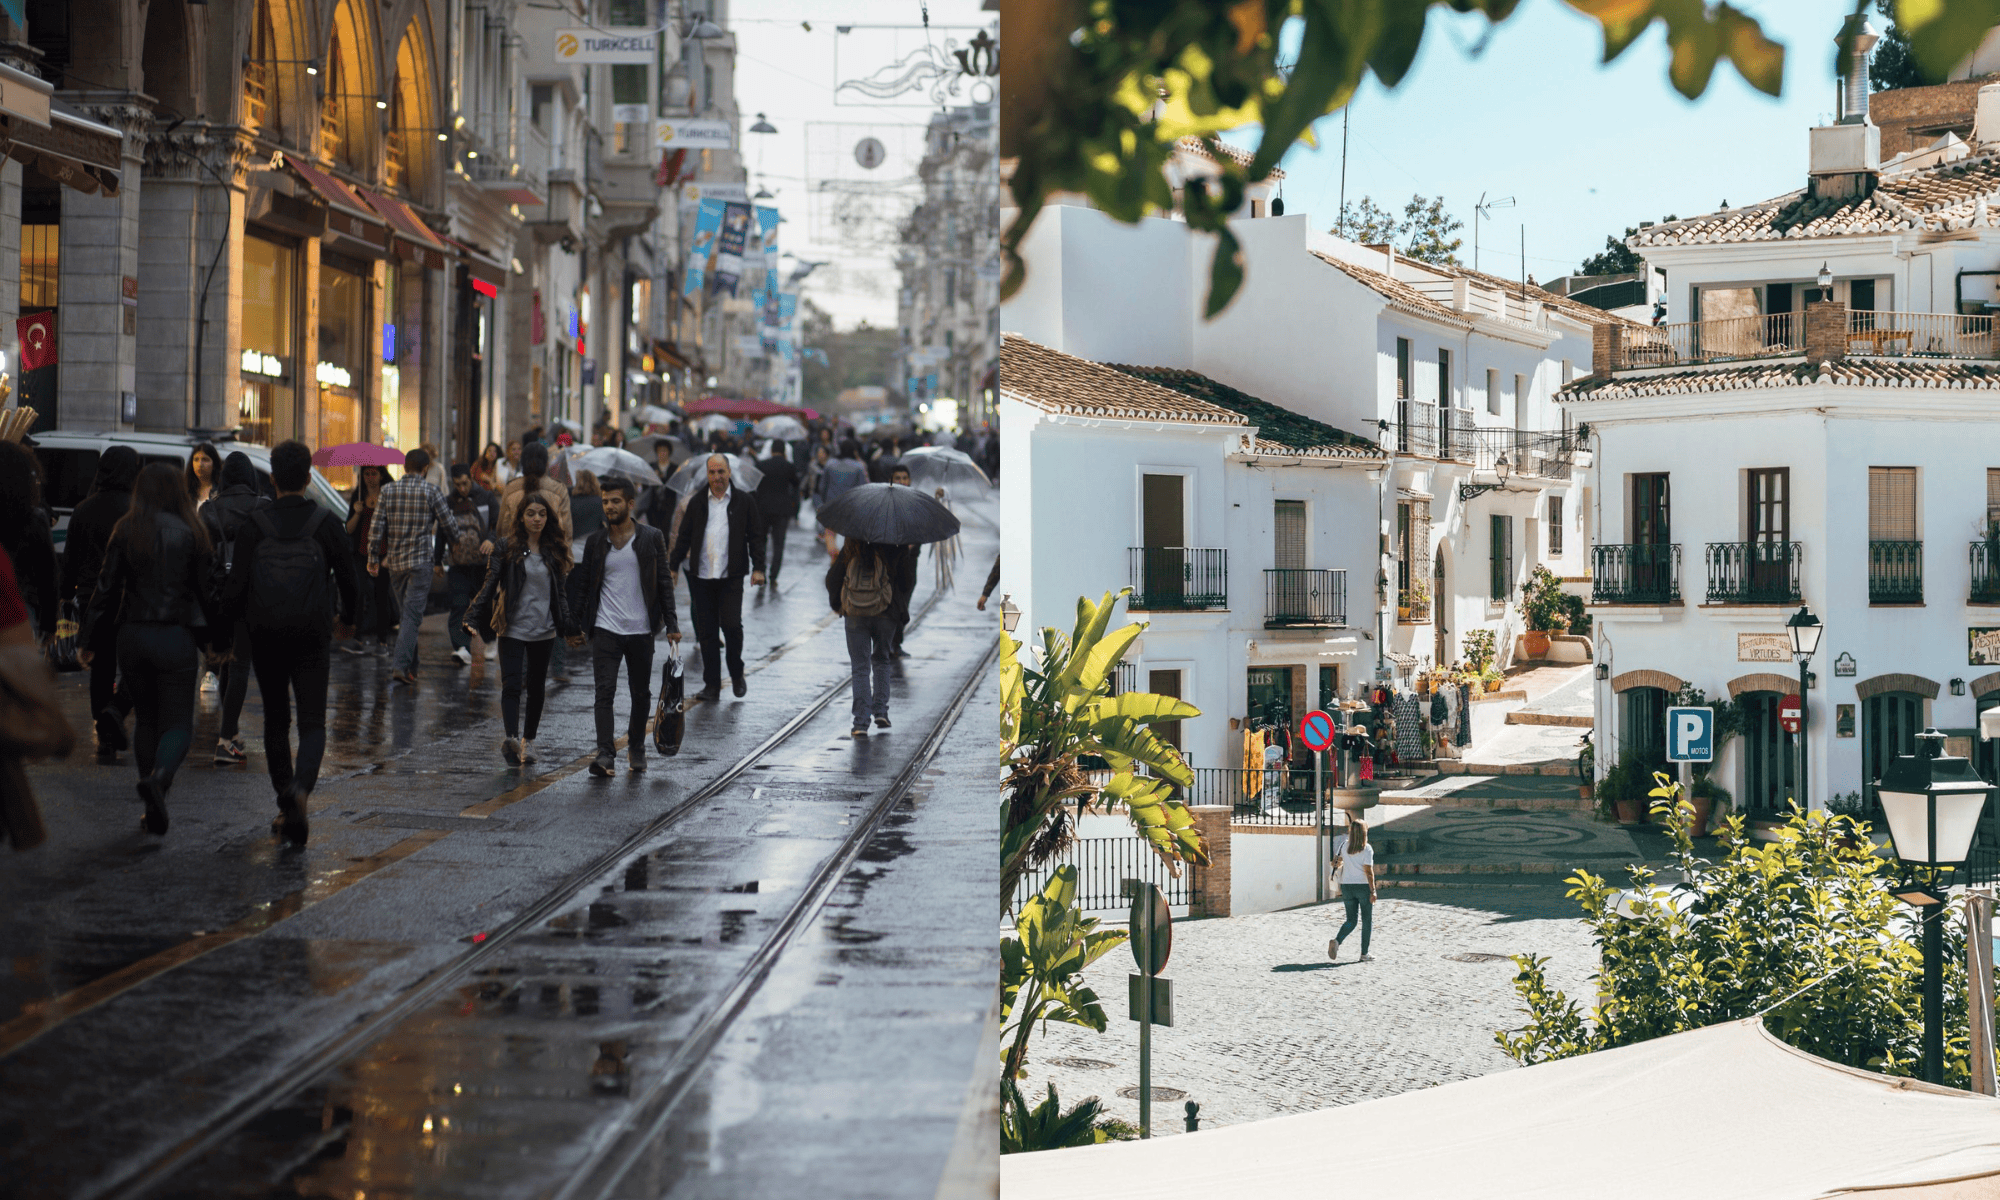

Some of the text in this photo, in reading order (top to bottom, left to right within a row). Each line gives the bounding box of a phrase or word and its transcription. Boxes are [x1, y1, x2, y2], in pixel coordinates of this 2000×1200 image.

[583, 37, 655, 51] TURKCELL
[1750, 649, 1781, 660] VIRTUDES
[1677, 714, 1704, 755] P
[1690, 747, 1709, 755] MOTOS
